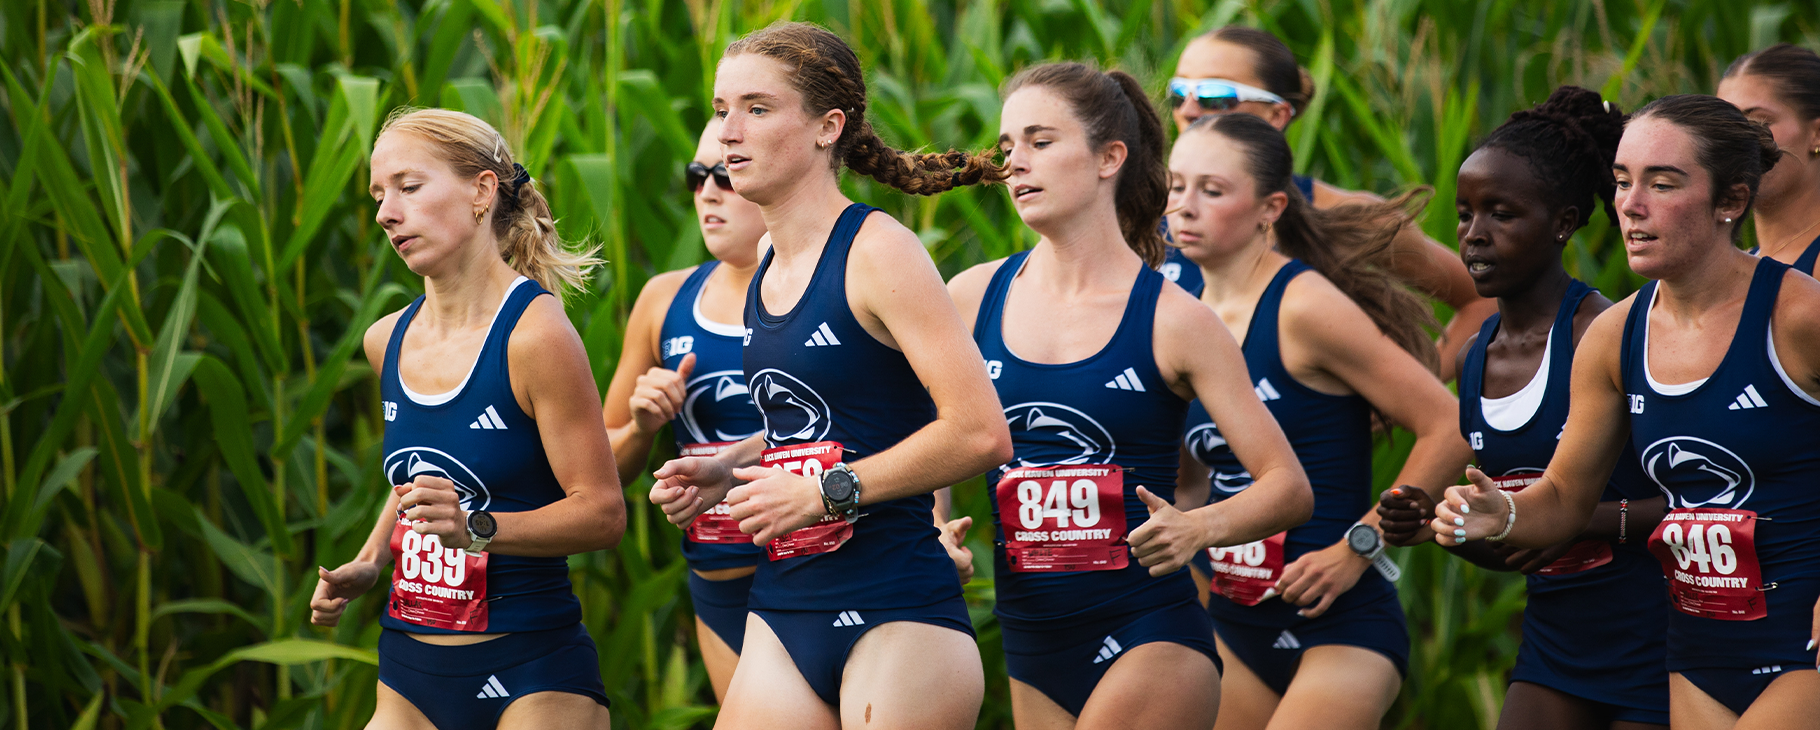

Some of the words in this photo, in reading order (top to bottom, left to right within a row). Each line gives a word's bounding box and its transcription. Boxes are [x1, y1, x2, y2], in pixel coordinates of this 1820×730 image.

[790, 445, 831, 457] UNIVERSITY
[1025, 470, 1054, 478] HAVEN
[1055, 469, 1109, 477] UNIVERSITY
[1502, 479, 1524, 488] HAVEN
[1017, 479, 1101, 529] 849
[1695, 513, 1744, 522] UNIVERSITY
[1015, 531, 1049, 542] CROSS
[1051, 528, 1112, 541] COUNTRY
[1109, 548, 1122, 566] F
[1662, 523, 1737, 575] 846
[401, 530, 466, 587] 839
[1230, 563, 1273, 580] COUNTRY
[1674, 569, 1694, 585] CROSS
[1695, 576, 1748, 588] COUNTRY
[424, 584, 475, 600] COUNTRY
[1747, 597, 1757, 611] F
[469, 609, 478, 625] F
